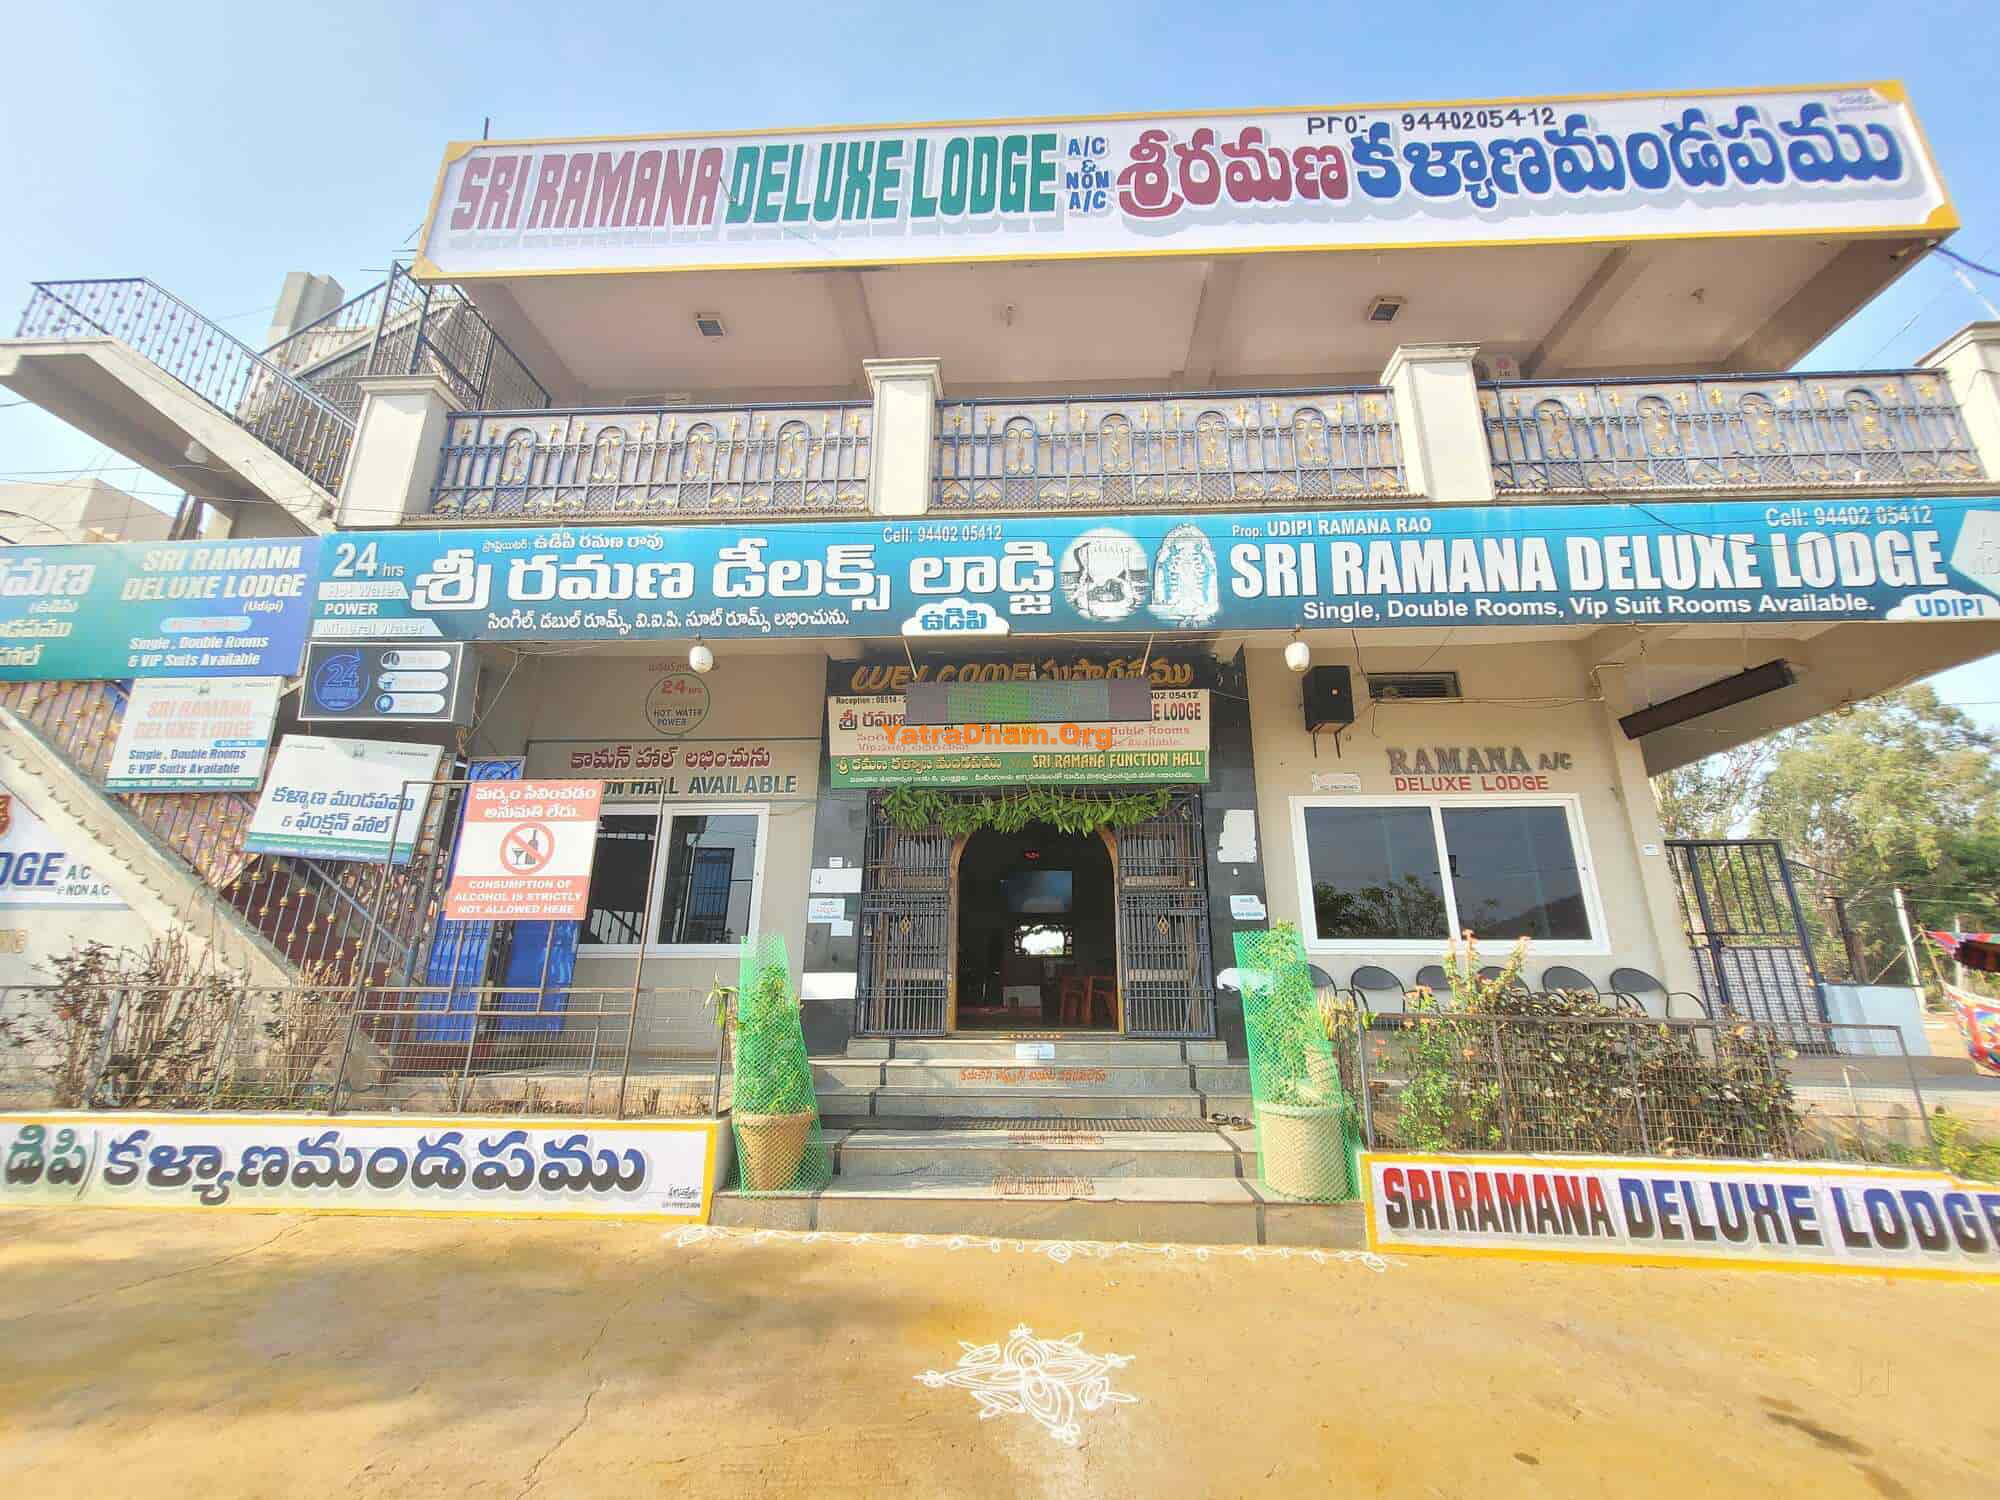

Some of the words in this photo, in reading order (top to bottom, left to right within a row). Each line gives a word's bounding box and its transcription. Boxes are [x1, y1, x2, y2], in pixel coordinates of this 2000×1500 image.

[1401, 106, 1554, 132] 9440205412
[1067, 135, 1105, 157] A/C
[1081, 159, 1096, 174] &
[449, 153, 533, 231] SRI
[527, 147, 726, 229] RAMANA
[724, 139, 904, 224] DELUXE
[910, 132, 1058, 218] LODGE
[1066, 170, 1109, 190] NON
[1069, 191, 1106, 213] A/C
[1266, 519, 1313, 537] UDIPI
[1318, 518, 1392, 536] RAMANA
[1395, 516, 1432, 534] RAO
[1765, 507, 1808, 527] Cell:
[1814, 506, 1871, 526] 94402
[1875, 505, 1933, 525] 05412
[882, 526, 913, 544] Cell:
[917, 525, 959, 543] 94402
[961, 524, 1002, 542] 05412
[143, 549, 186, 572] SRI
[189, 546, 304, 571] RAMANA
[332, 542, 378, 577] 24
[382, 562, 405, 577] hrs
[1229, 541, 1318, 599] SRI
[1330, 536, 1558, 598] RAMANA
[1565, 532, 1762, 592] DELUXE
[1770, 529, 1949, 590] LODGE
[411, 549, 492, 611] శ్రీ
[507, 553, 695, 600] రమణ
[712, 537, 891, 611] డీలక్స్
[120, 576, 223, 601] DELUXE
[223, 573, 308, 599] LODGE
[324, 602, 378, 616] POWER
[1303, 600, 1381, 623] Single,
[1388, 599, 1471, 619] Double
[1475, 599, 1565, 619] Rooms,
[1569, 597, 1608, 619] Vip
[1614, 596, 1662, 615] Suit
[1668, 596, 1752, 615] Rooms
[1758, 592, 1875, 614] Available.
[1914, 598, 1985, 617] UDIPI
[179, 635, 224, 650] Double
[225, 635, 269, 649] Rooms
[141, 654, 163, 668] VIP
[200, 653, 261, 667] Available
[326, 663, 360, 688] 24
[661, 679, 686, 695] 24
[1163, 702, 1201, 721] LODGE
[170, 748, 208, 760] Double
[209, 749, 247, 760] Rooms
[570, 744, 632, 769] కామన్
[635, 745, 679, 768] హాల్
[1054, 753, 1106, 769] RAMANA
[1109, 752, 1168, 768] FUNCTION
[1172, 751, 1201, 767] HALL
[1386, 746, 1532, 775] RAMANA
[139, 764, 157, 775] VIP
[189, 763, 241, 775] Available
[631, 775, 680, 795] HALL
[687, 774, 798, 795] AVAILABLE
[1394, 776, 1471, 792] DELUXE
[1482, 775, 1549, 792] LODGE
[469, 879, 554, 889] CONSUMPTION
[556, 879, 572, 889] OF
[455, 892, 508, 902] ALCOHOL
[512, 892, 526, 902] IS
[526, 892, 583, 901] STRICTLY
[457, 904, 482, 914] NOT
[484, 904, 541, 914] ALLOWED
[543, 904, 577, 914] HERE
[1618, 1177, 1825, 1249] DELUXE
[1830, 1187, 2000, 1255] LODGE
